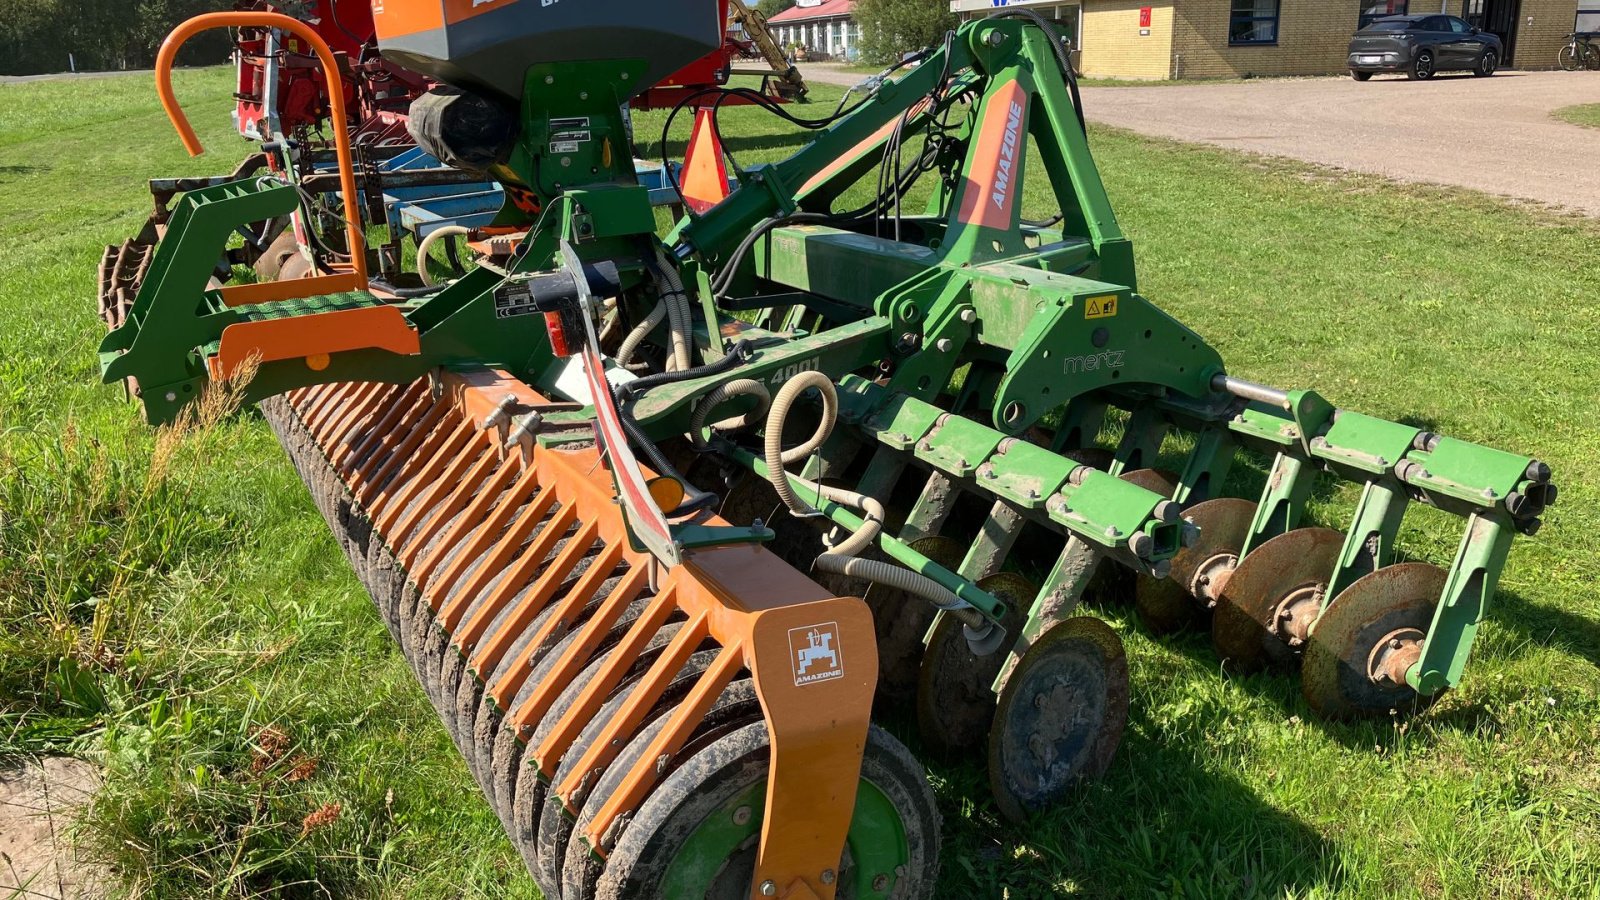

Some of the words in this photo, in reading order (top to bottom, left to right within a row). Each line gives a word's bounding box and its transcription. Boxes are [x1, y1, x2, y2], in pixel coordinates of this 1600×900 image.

[992, 100, 1022, 210] AMAZONE
[770, 355, 820, 385] 4001
[1063, 349, 1126, 375] mertz
[797, 669, 841, 683] AMAZONE
